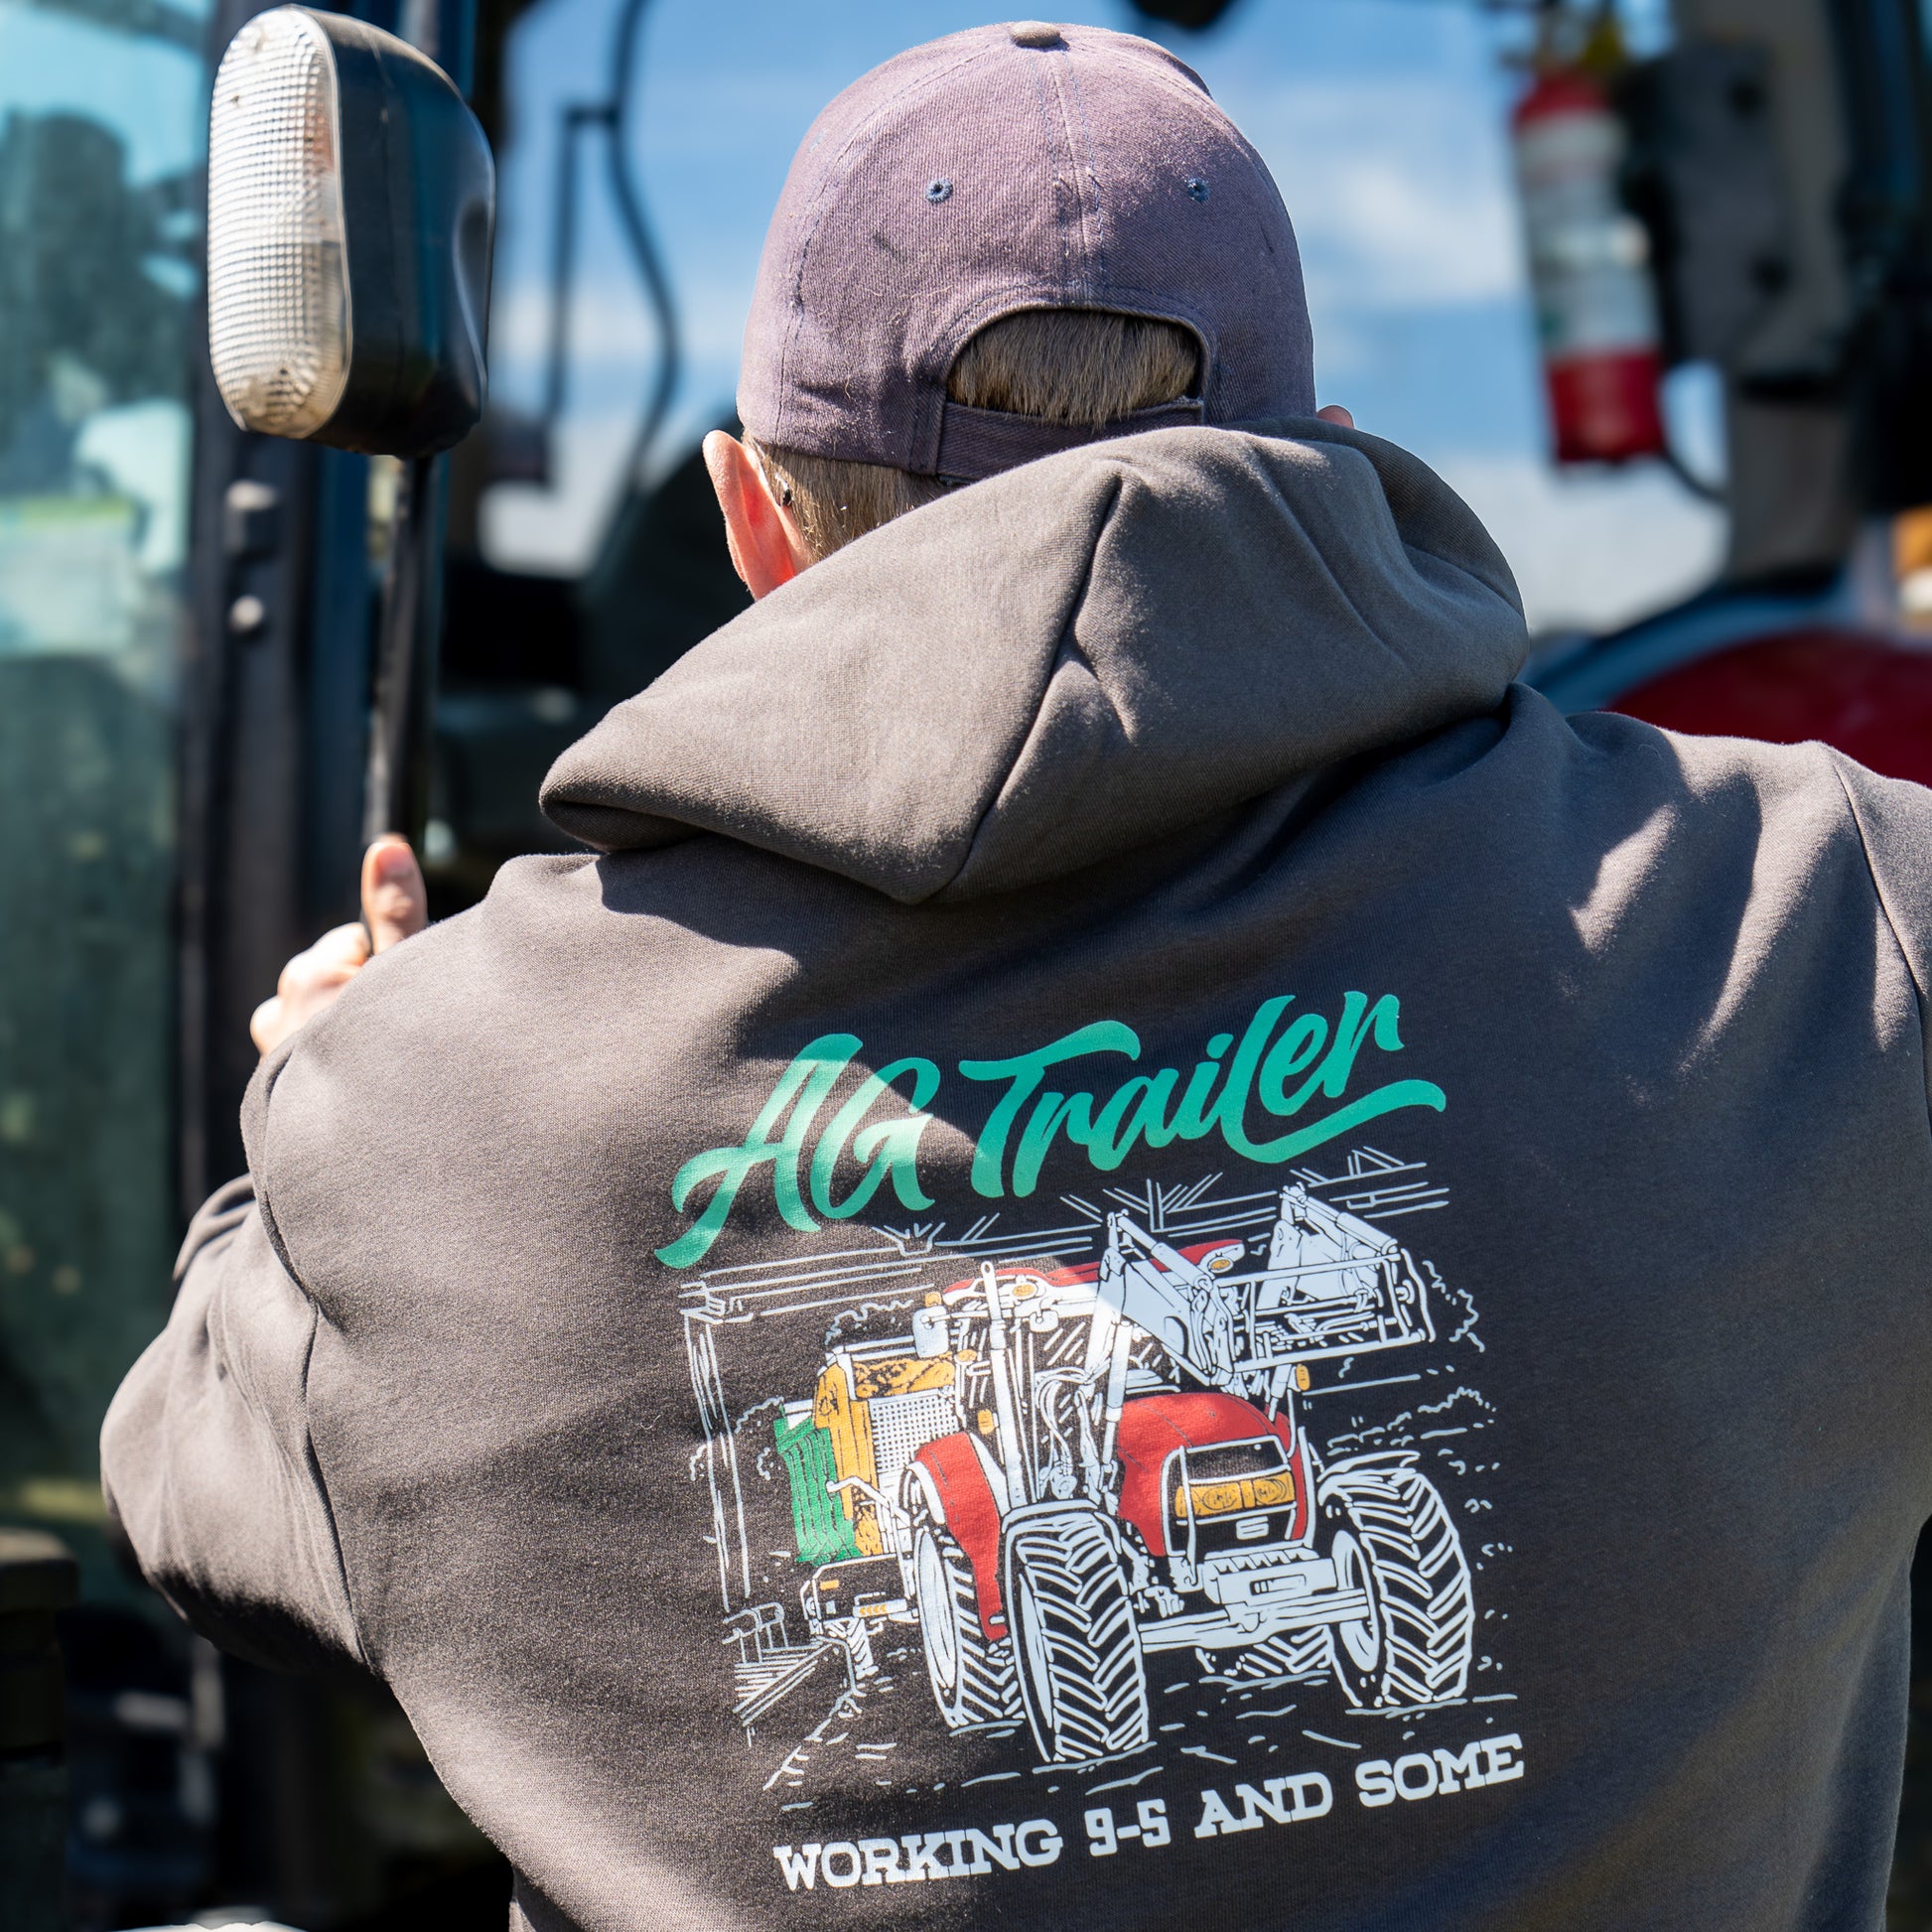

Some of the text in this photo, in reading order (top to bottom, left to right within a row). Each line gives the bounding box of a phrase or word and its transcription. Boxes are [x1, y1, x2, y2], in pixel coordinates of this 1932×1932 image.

[654, 991, 1447, 1269] AG Trailer
[773, 1733, 1525, 1891] WORKING 9-5 AND SOME
